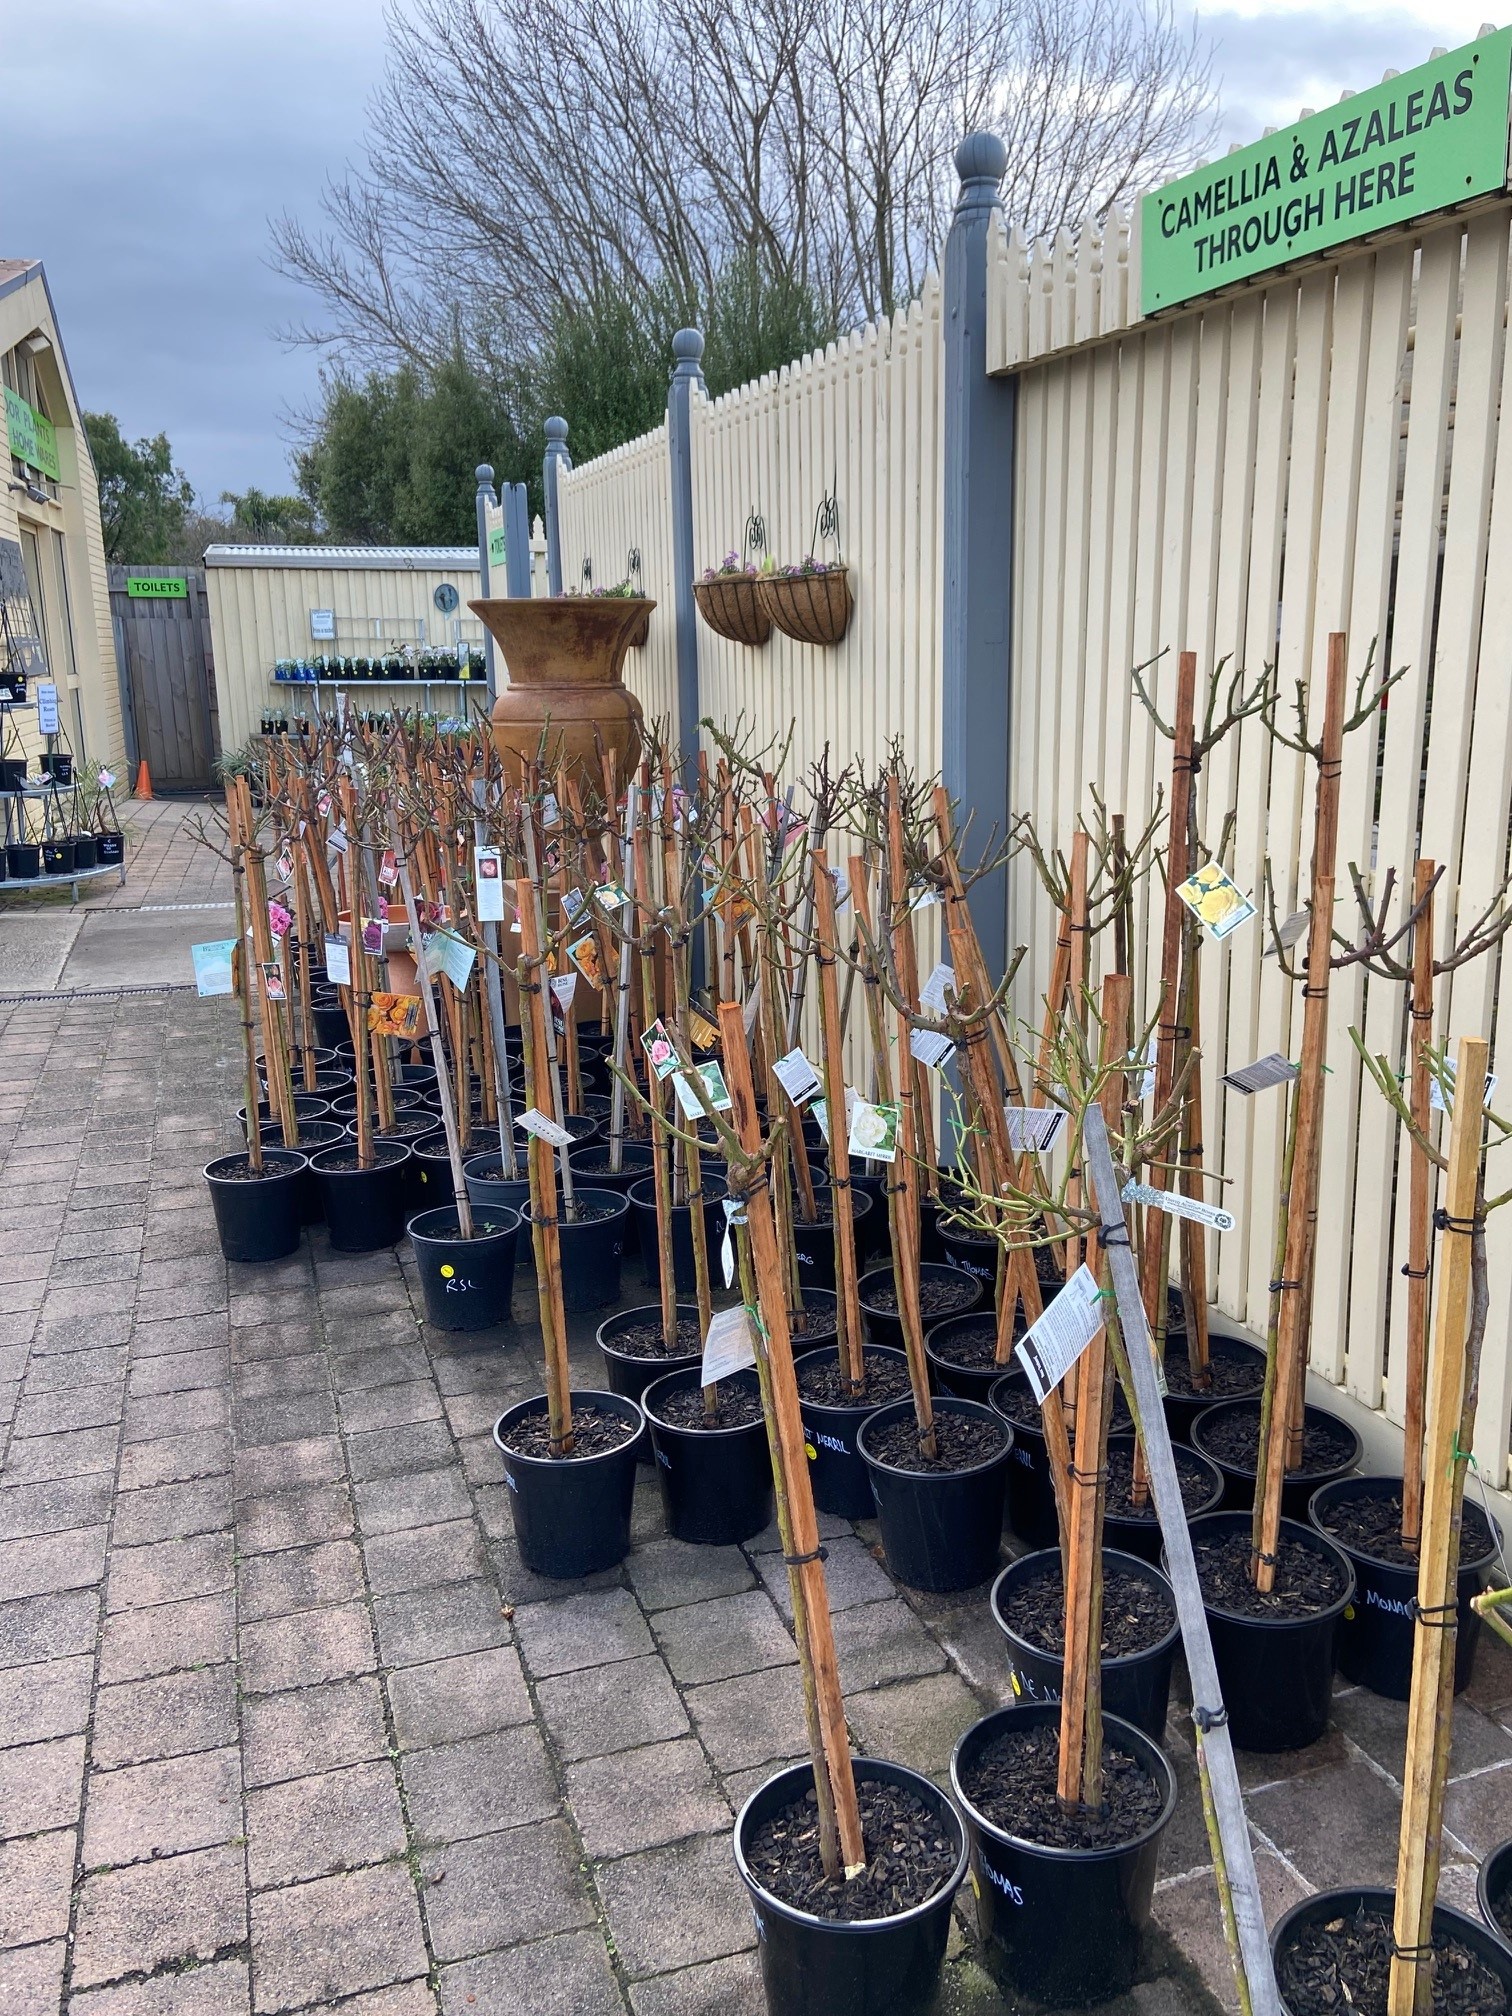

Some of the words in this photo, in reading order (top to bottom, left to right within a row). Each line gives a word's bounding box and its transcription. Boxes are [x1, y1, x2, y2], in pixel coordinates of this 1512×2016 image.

[1161, 155, 1281, 239] CAMELLIA
[1290, 143, 1310, 183] &
[1317, 70, 1474, 173] AZALEAS
[1194, 188, 1325, 274] THROUGH
[1334, 151, 1417, 221] HERE
[13, 427, 34, 457] HOME
[23, 410, 50, 445] PLANTS
[133, 582, 180, 592] TOILETS
[446, 1278, 484, 1293] RSL
